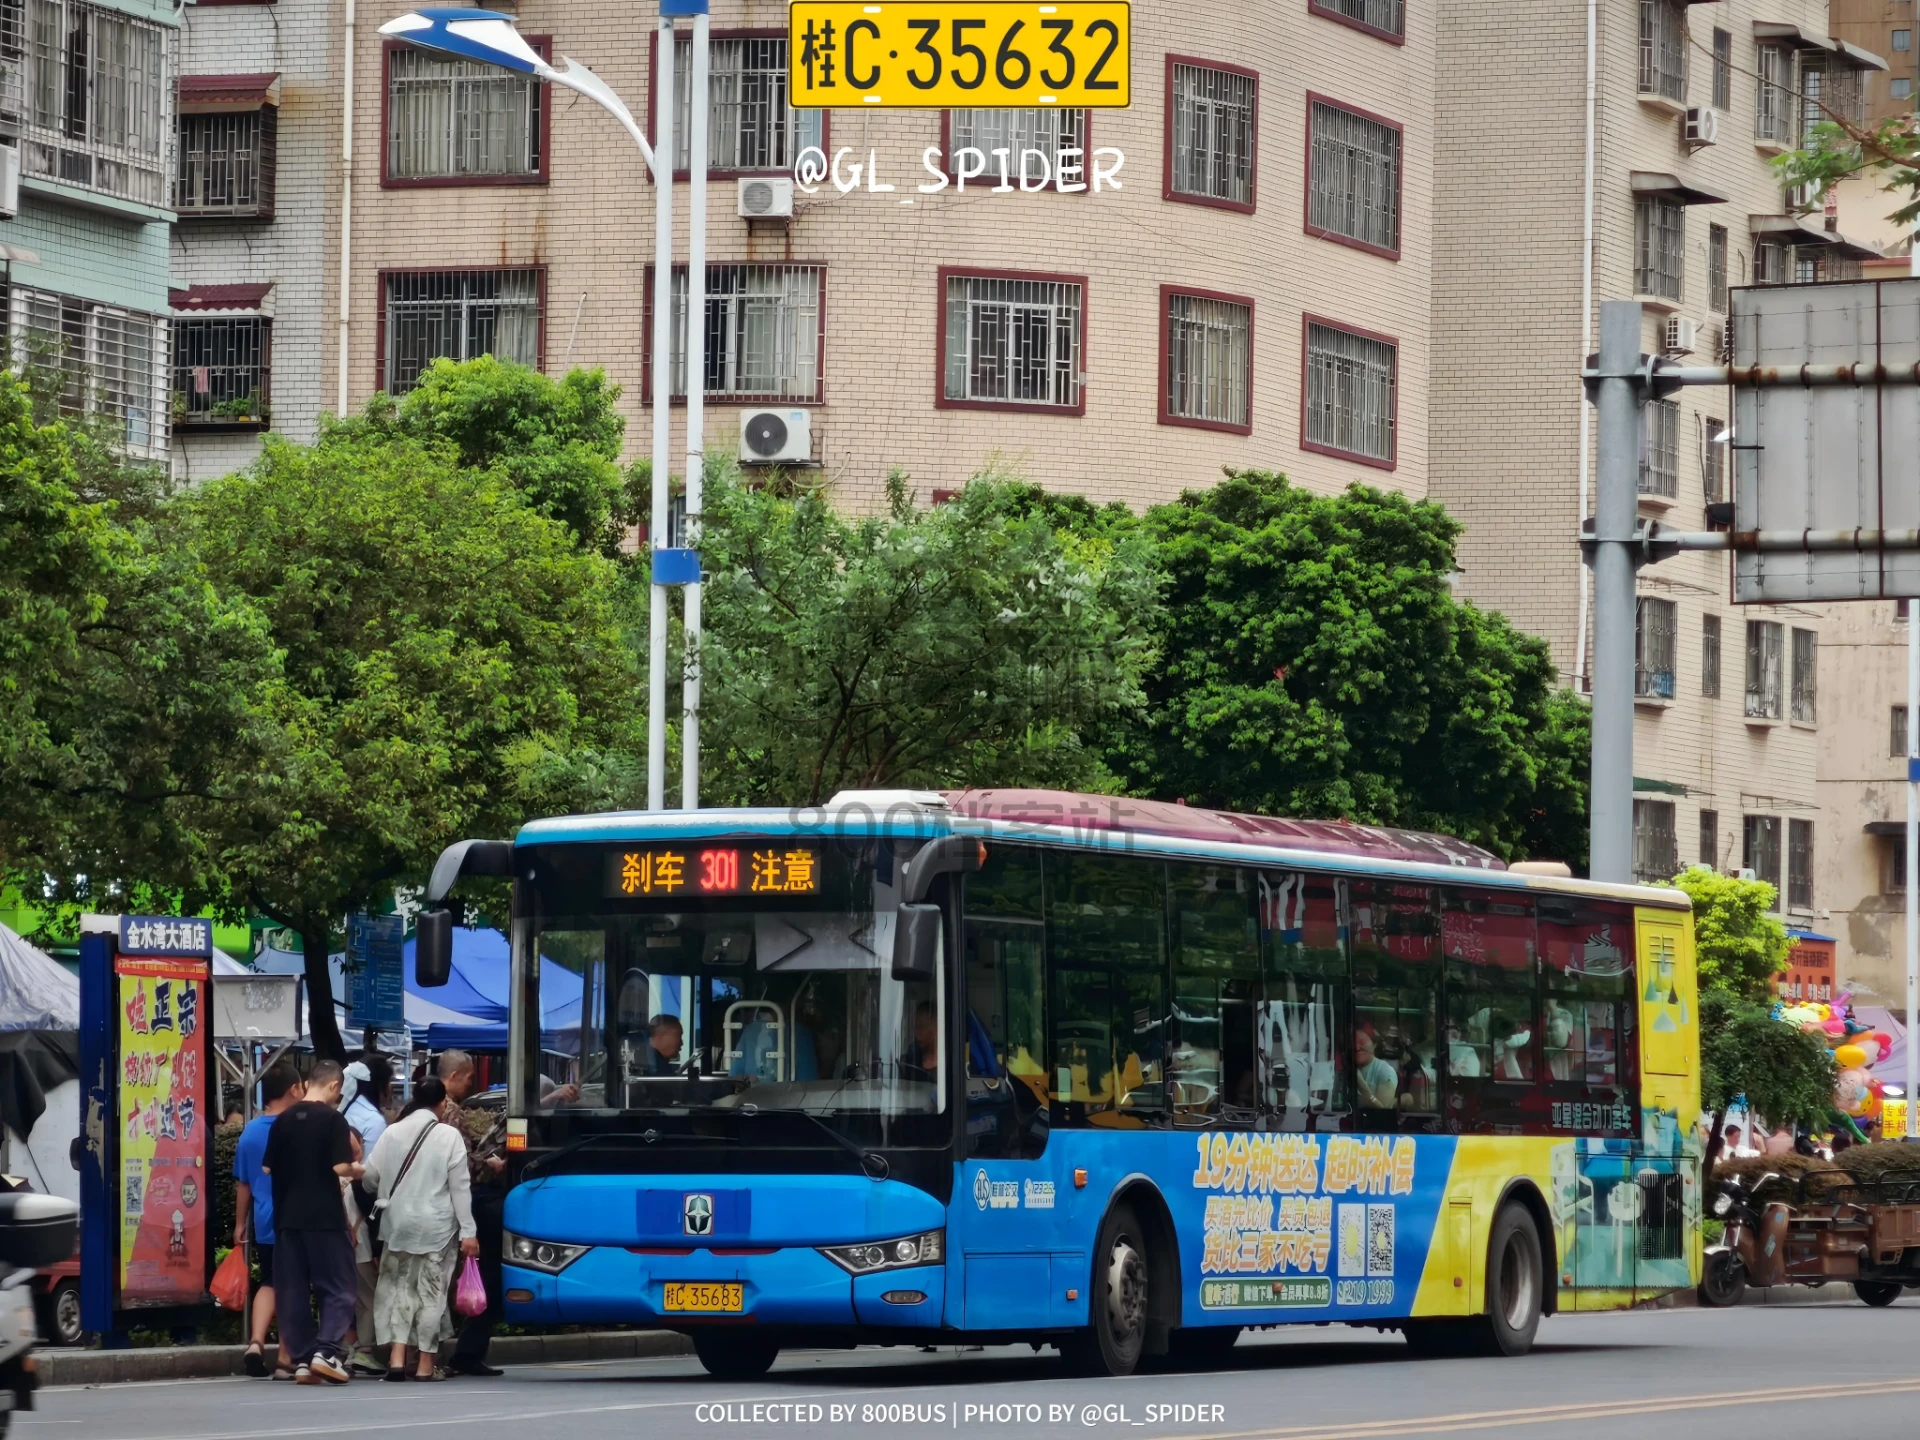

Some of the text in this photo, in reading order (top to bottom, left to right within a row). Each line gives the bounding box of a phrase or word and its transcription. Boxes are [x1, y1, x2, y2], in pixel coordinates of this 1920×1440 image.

[621, 849, 815, 893] 刹车 301 注意
[126, 920, 206, 951] 金水湾大酒店
[1551, 1102, 1632, 1129] 亚星混合动力客车
[1193, 1132, 1416, 1196] 19分钟送达 超时补偿
[1204, 1195, 1333, 1231] 买酒先比价 买贵包退
[1201, 1230, 1331, 1275] 货比三家不吃亏
